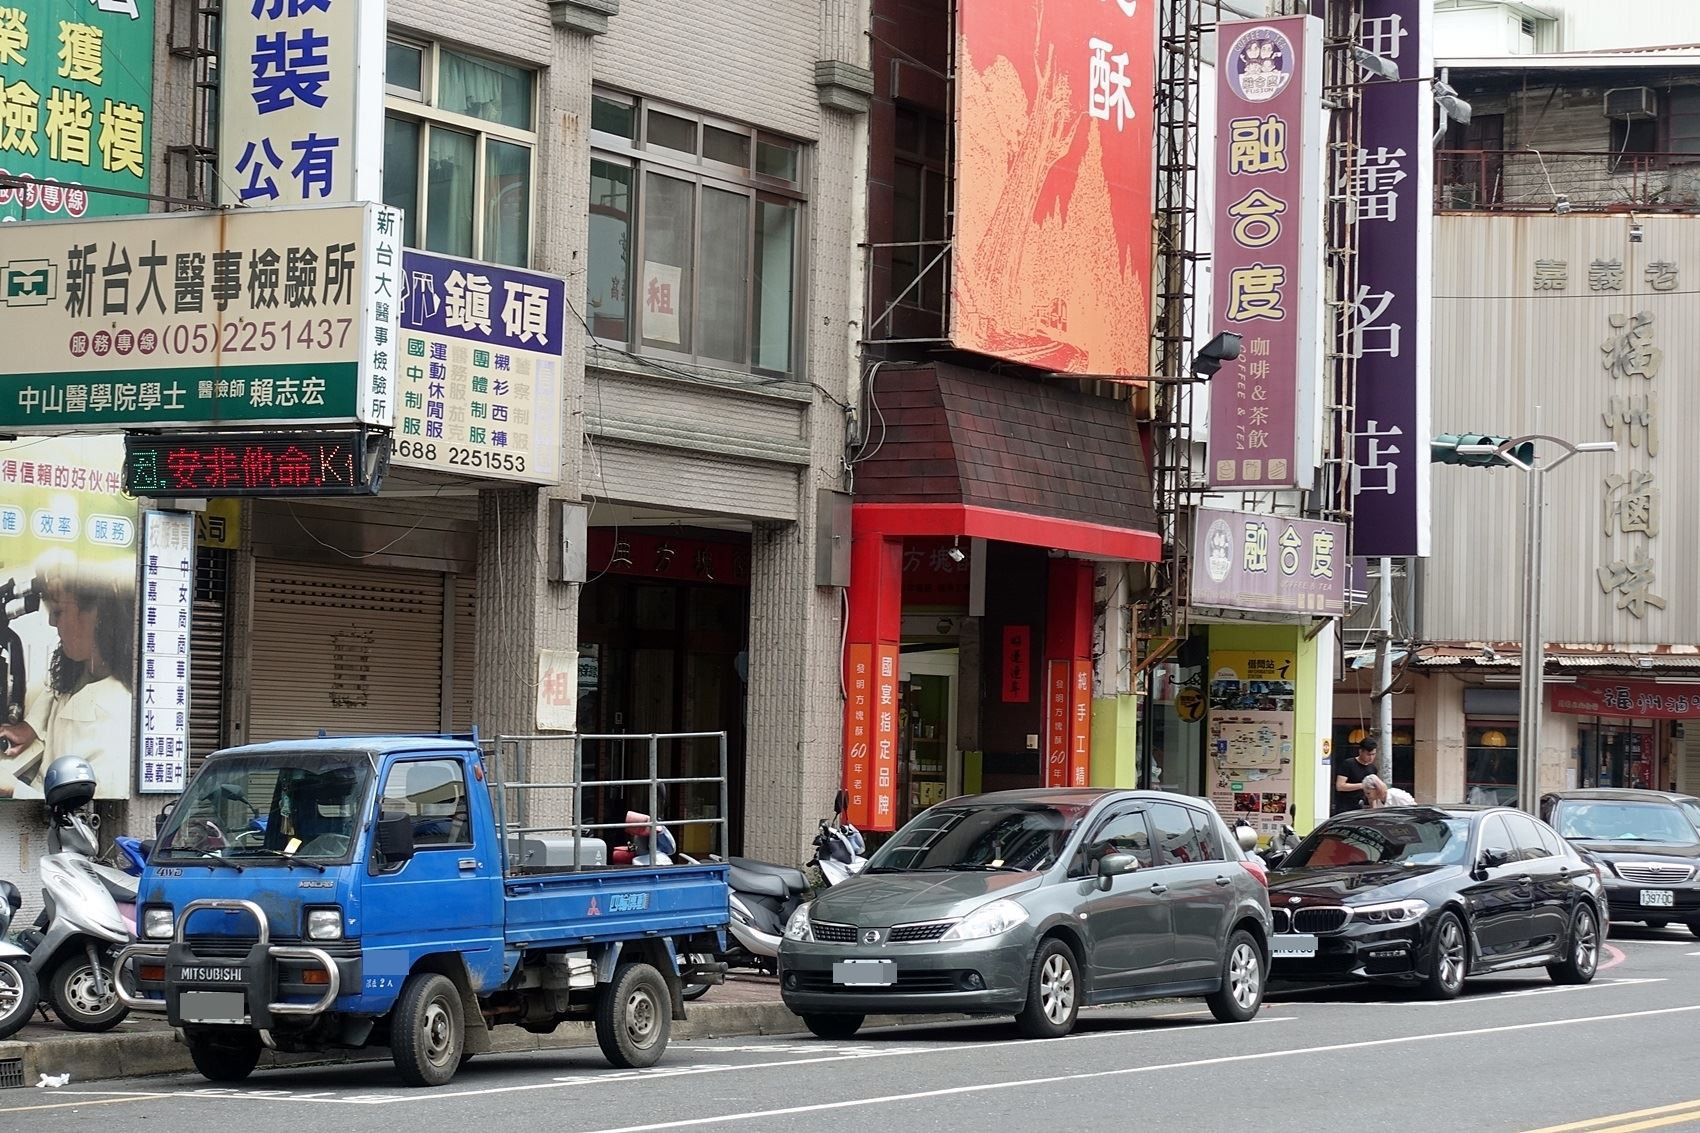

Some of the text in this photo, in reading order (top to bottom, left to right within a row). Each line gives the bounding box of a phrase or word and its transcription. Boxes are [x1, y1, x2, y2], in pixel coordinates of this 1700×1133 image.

[0, 6, 103, 86] 榮獲
[1227, 113, 1287, 323] 融合度
[65, 239, 356, 319] 新台大醫事檢驗所
[647, 276, 674, 315] 租
[69, 318, 353, 357] 服務專線 (05)2251437
[371, 210, 394, 420] 新台大醫事檢驗所
[18, 376, 326, 414] 中山醫學院學士 醫檢師 賴志宏
[403, 338, 425, 435] 國中制服
[426, 342, 447, 439] 運動休閒服
[469, 349, 490, 445] 團體制服
[1237, 345, 1247, 399] COFFEE
[491, 353, 511, 448] 襯衫西褲
[449, 447, 525, 473] 2251553
[1236, 425, 1246, 450] TEA
[1596, 310, 1666, 618] 福州滷味
[2, 460, 119, 493] 得信賴的好伙伴
[41, 515, 72, 536] 效率
[94, 520, 125, 541] 服務
[1243, 521, 1335, 579] 融合度
[542, 667, 572, 706] 租
[878, 656, 893, 816] 國宴指定品牌
[1050, 680, 1066, 788] 發明方塊酥60年
[155, 866, 184, 878] 4WD
[181, 967, 243, 982] MITSUBISHI
